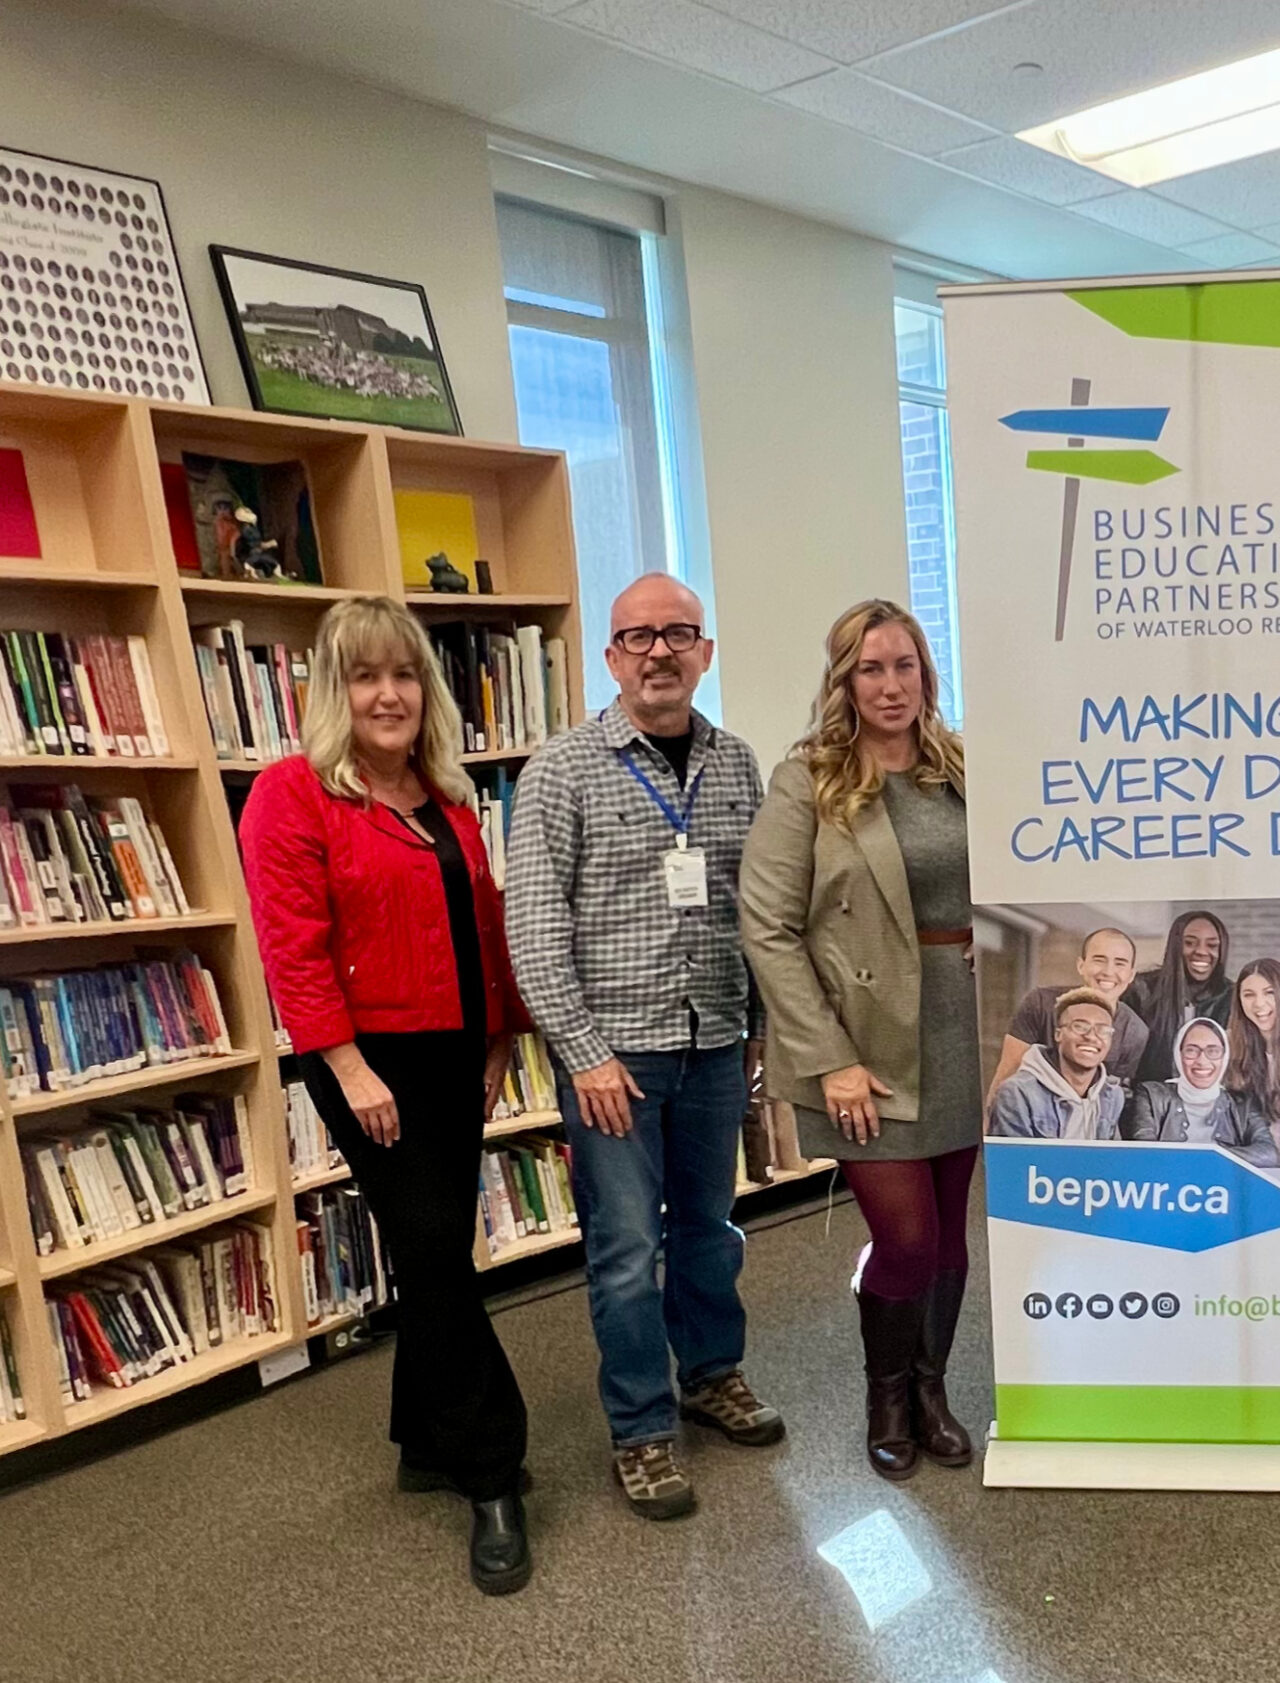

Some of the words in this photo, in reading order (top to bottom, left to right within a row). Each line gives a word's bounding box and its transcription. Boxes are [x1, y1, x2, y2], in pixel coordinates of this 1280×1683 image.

[1097, 623, 1125, 640] OF
[1133, 617, 1253, 639] WATERLOO
[1042, 755, 1224, 805] EVERY
[1011, 813, 1251, 862] CAREER
[1027, 1165, 1230, 1216] bepwr.ca
